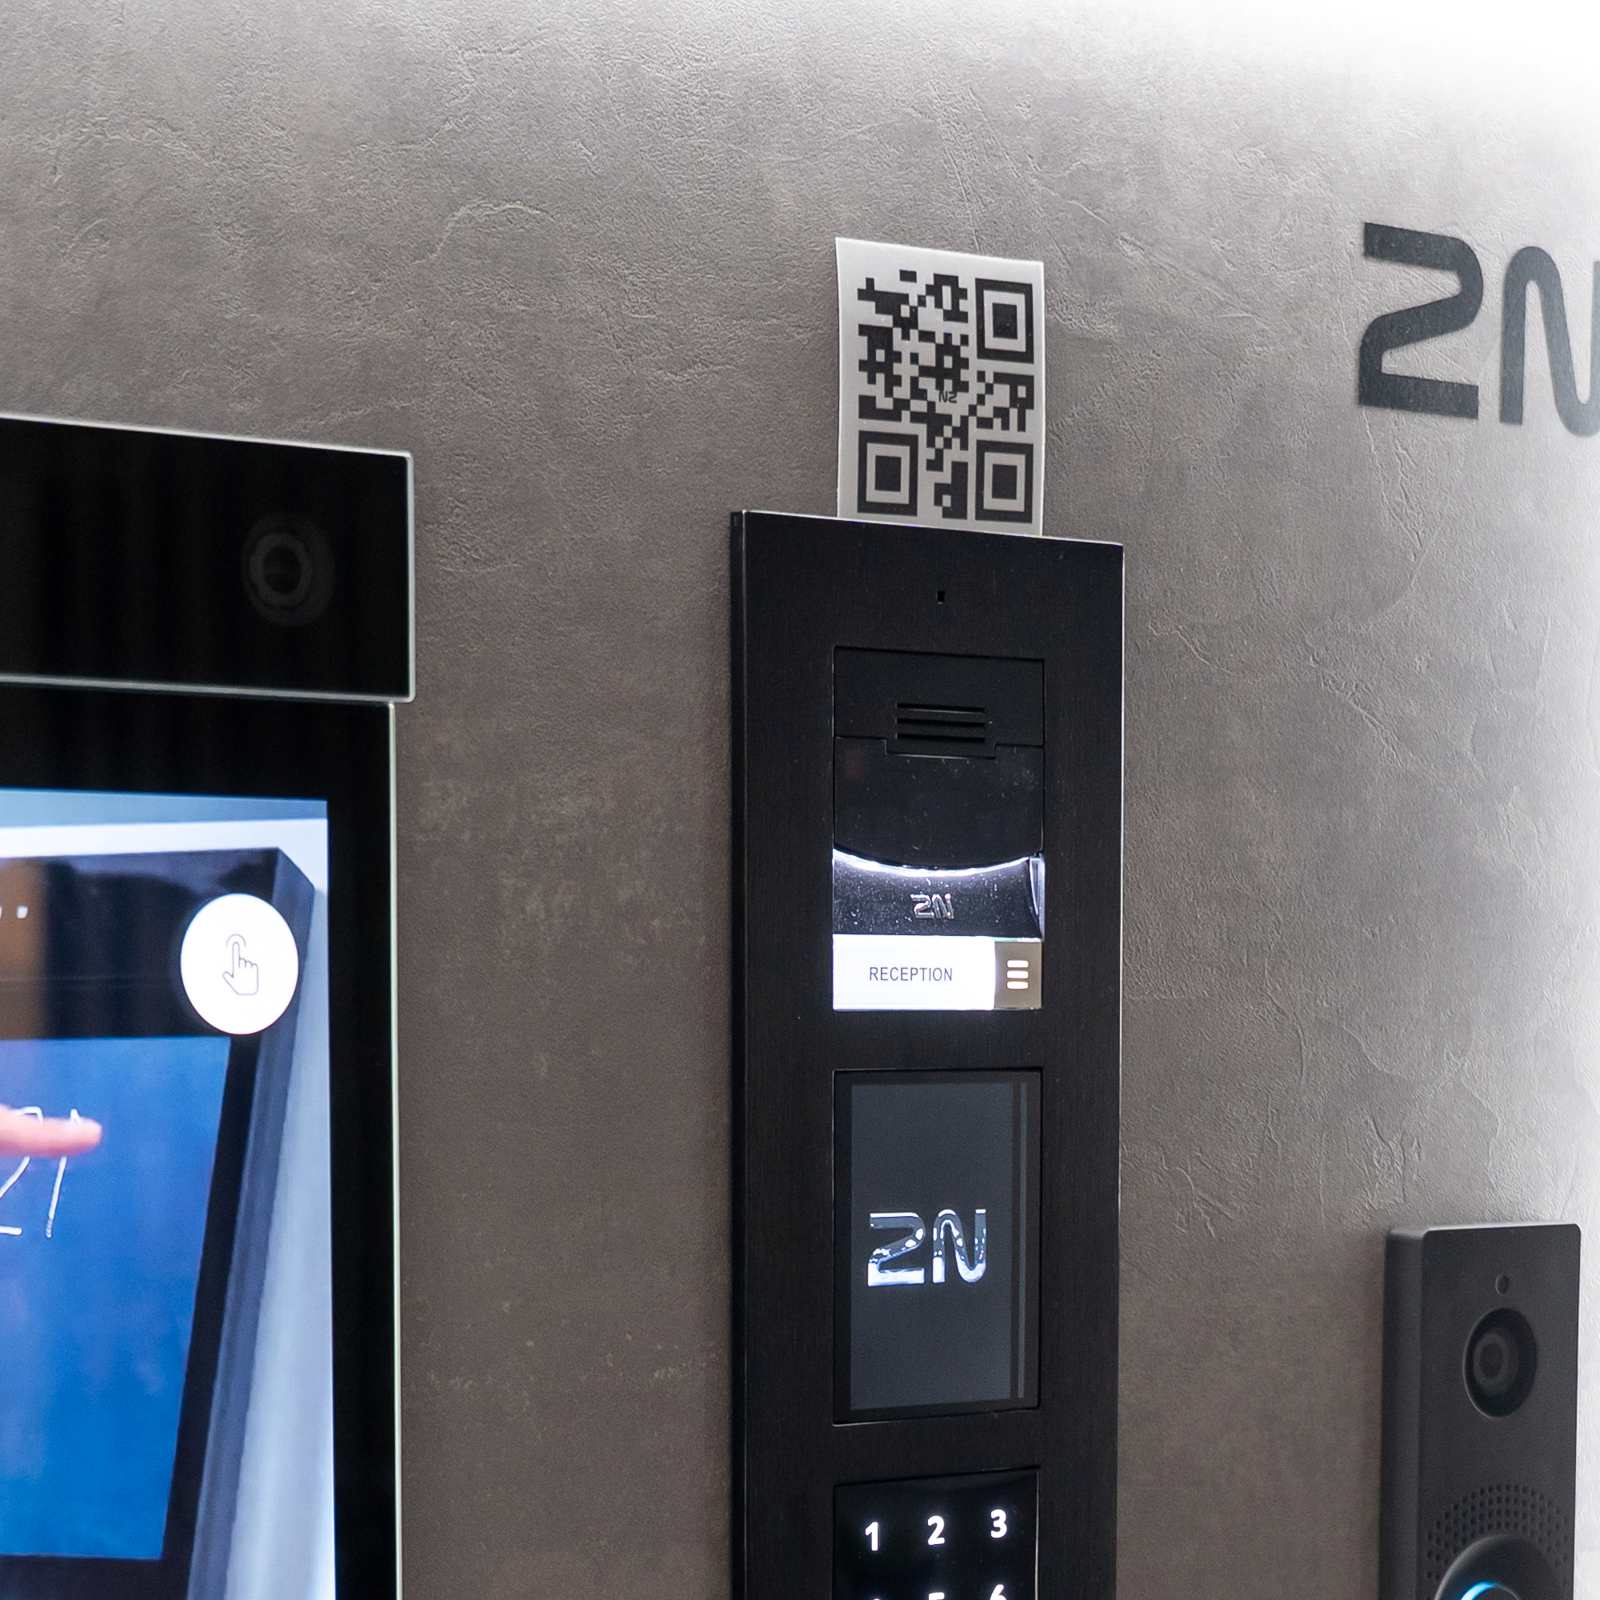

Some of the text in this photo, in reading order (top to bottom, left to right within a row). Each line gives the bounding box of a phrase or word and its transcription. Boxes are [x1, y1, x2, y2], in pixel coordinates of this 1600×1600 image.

[868, 966, 953, 982] RECEPTION
[866, 1208, 988, 1289] 2N
[864, 1508, 1008, 1552] 1 2 3
